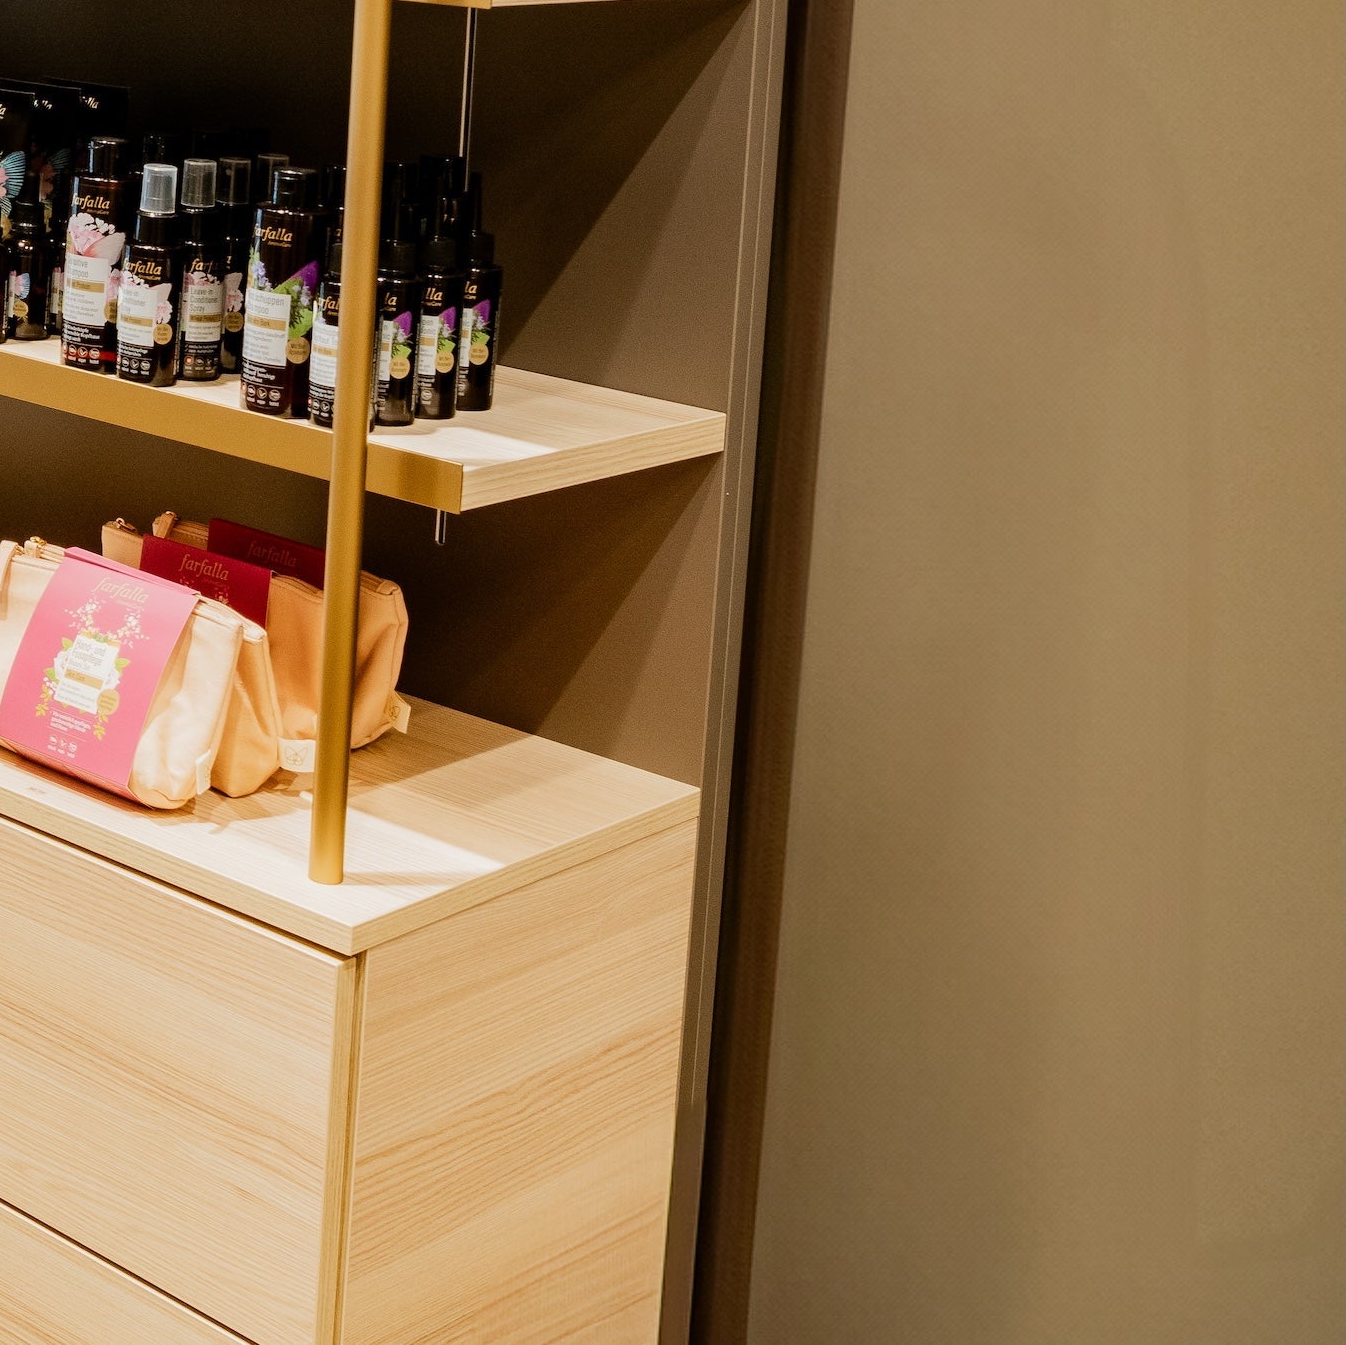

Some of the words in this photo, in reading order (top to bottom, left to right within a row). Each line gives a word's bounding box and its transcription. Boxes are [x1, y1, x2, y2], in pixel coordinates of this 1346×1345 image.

[71, 193, 110, 210] farfalla
[255, 223, 293, 242] farfalla
[66, 258, 89, 269] nsitive
[123, 257, 162, 275] farfalla
[66, 267, 89, 279] ampoo
[190, 287, 214, 296] Leave-in
[190, 304, 206, 313] Spray
[245, 540, 298, 569] farfalla
[179, 553, 230, 582] farfalla
[92, 577, 150, 604] farfalla
